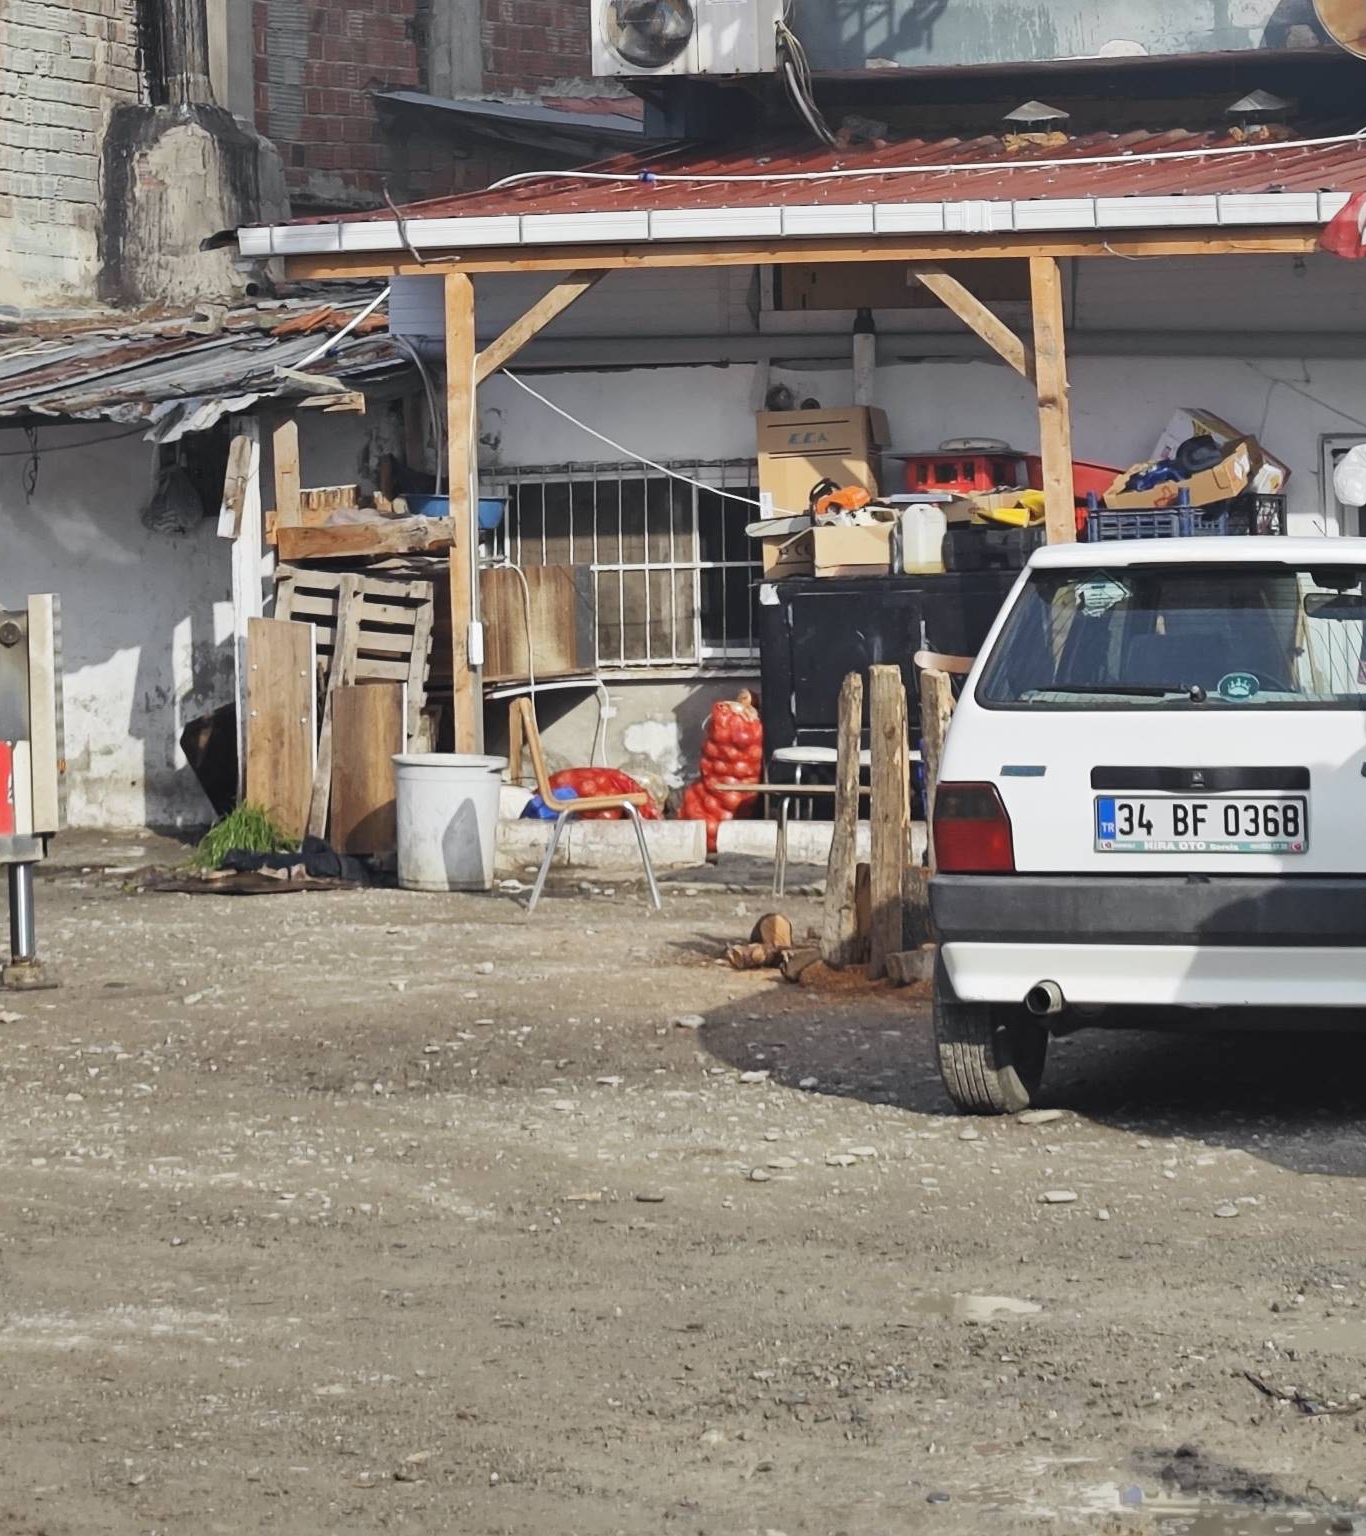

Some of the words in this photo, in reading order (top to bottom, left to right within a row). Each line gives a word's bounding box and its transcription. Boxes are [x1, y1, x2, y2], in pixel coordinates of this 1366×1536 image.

[1101, 822, 1115, 832] TR
[1117, 803, 1154, 836] 34
[1172, 803, 1209, 836] BF
[1223, 804, 1300, 837] 0368
